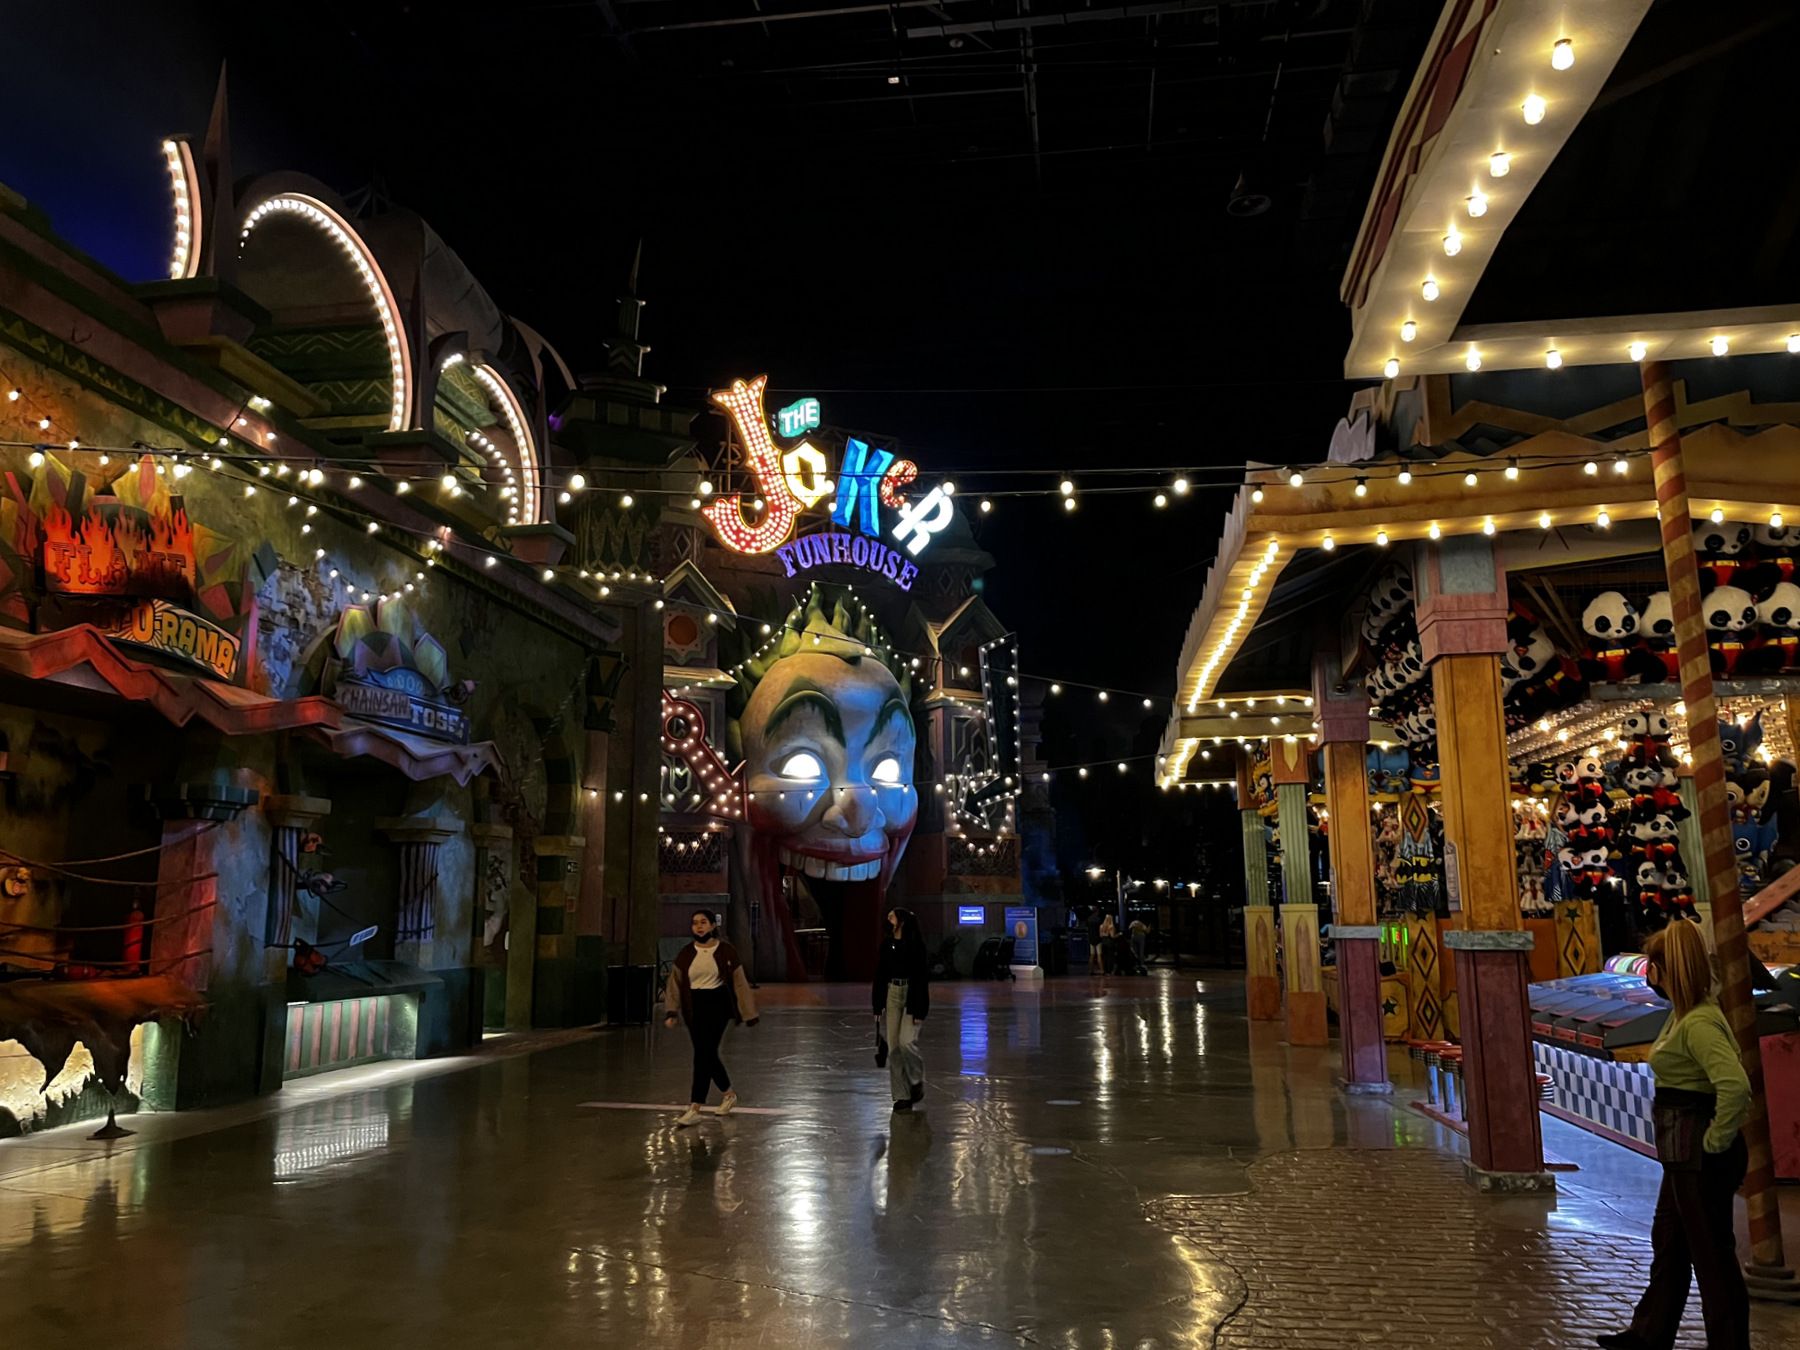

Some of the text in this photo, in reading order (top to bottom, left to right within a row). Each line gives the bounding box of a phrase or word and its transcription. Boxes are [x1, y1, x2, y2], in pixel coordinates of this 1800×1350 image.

[780, 401, 818, 433] THE
[702, 375, 953, 556] JOKER
[776, 532, 919, 592] FUNHOUSE
[341, 688, 409, 716] CHAINSAW
